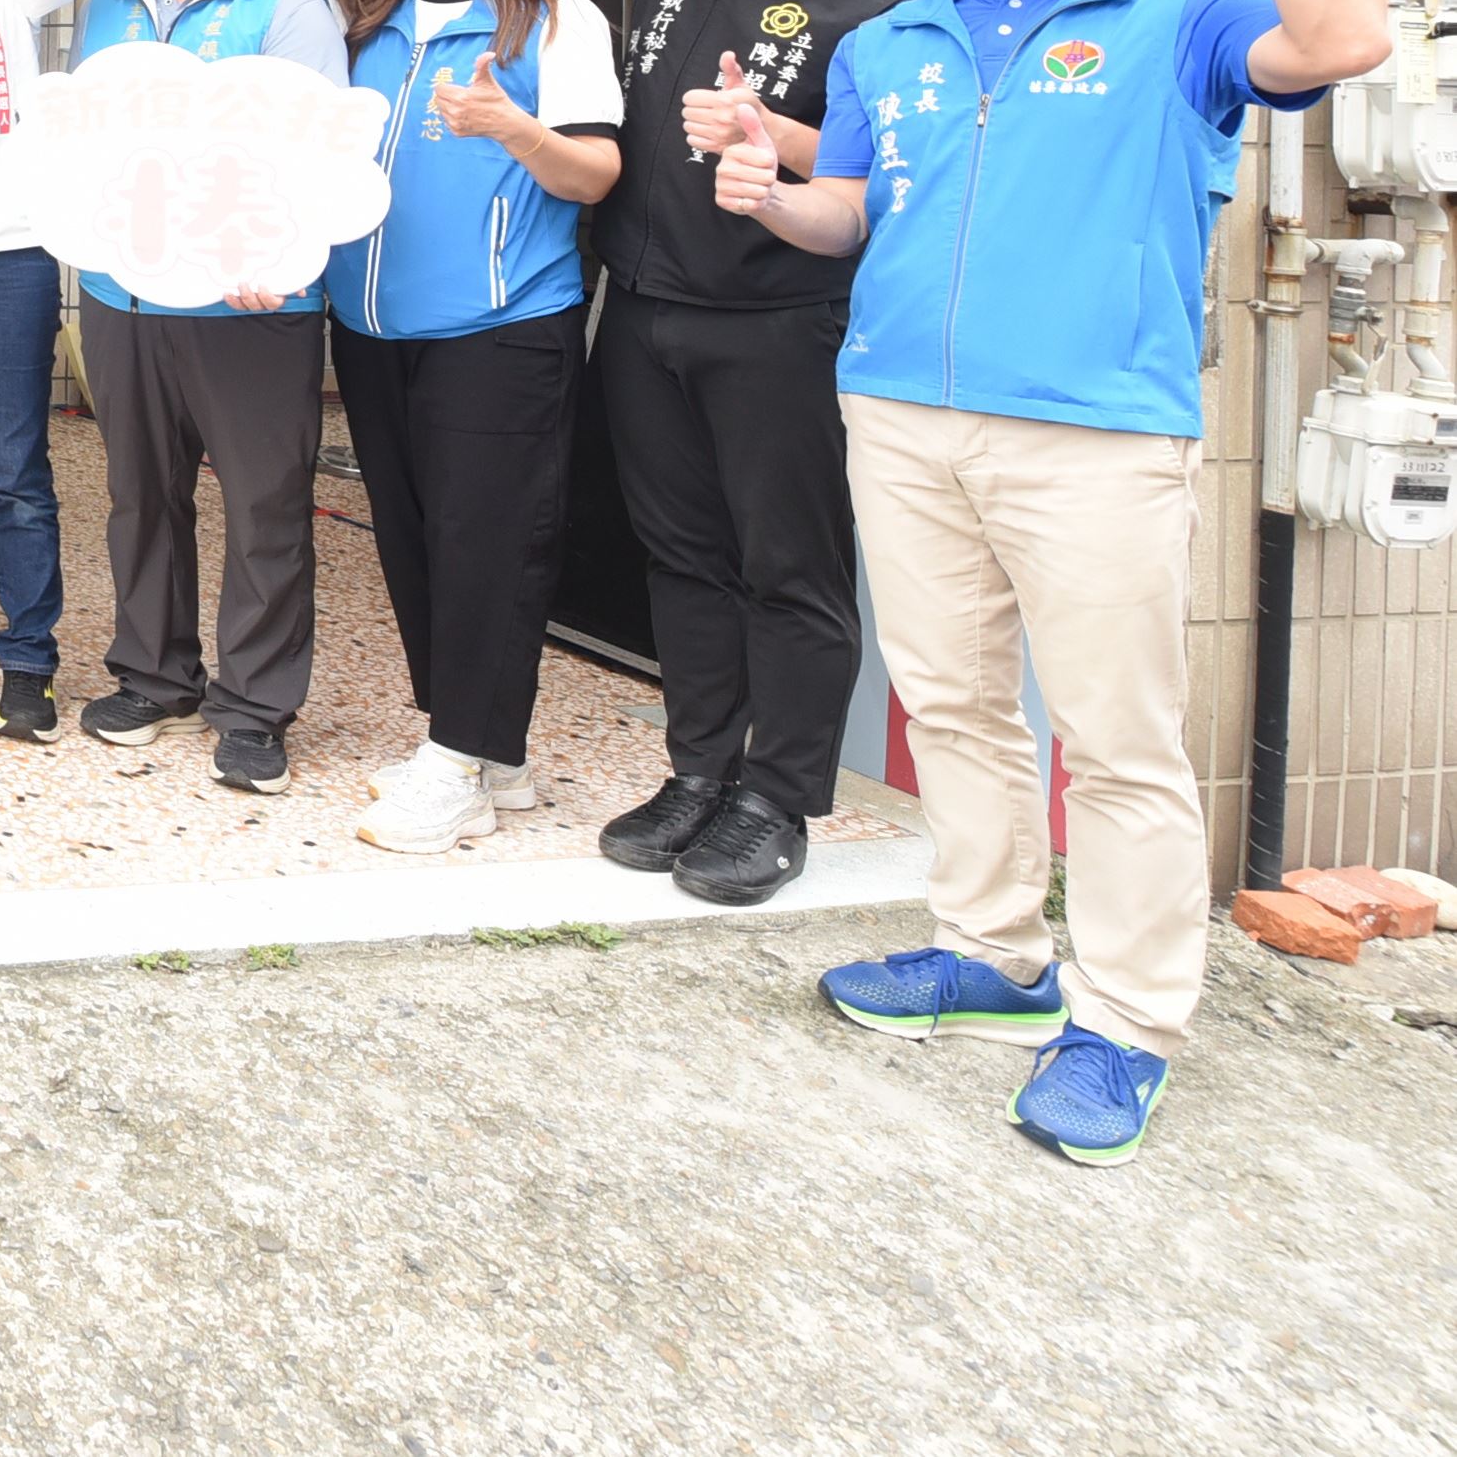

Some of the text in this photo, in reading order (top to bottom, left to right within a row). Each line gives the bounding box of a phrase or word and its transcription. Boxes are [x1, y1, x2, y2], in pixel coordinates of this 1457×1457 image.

[743, 42, 780, 98] 陳超
[770, 32, 814, 100] 立法委員
[914, 61, 946, 114] 校長
[105, 153, 285, 276] 棒
